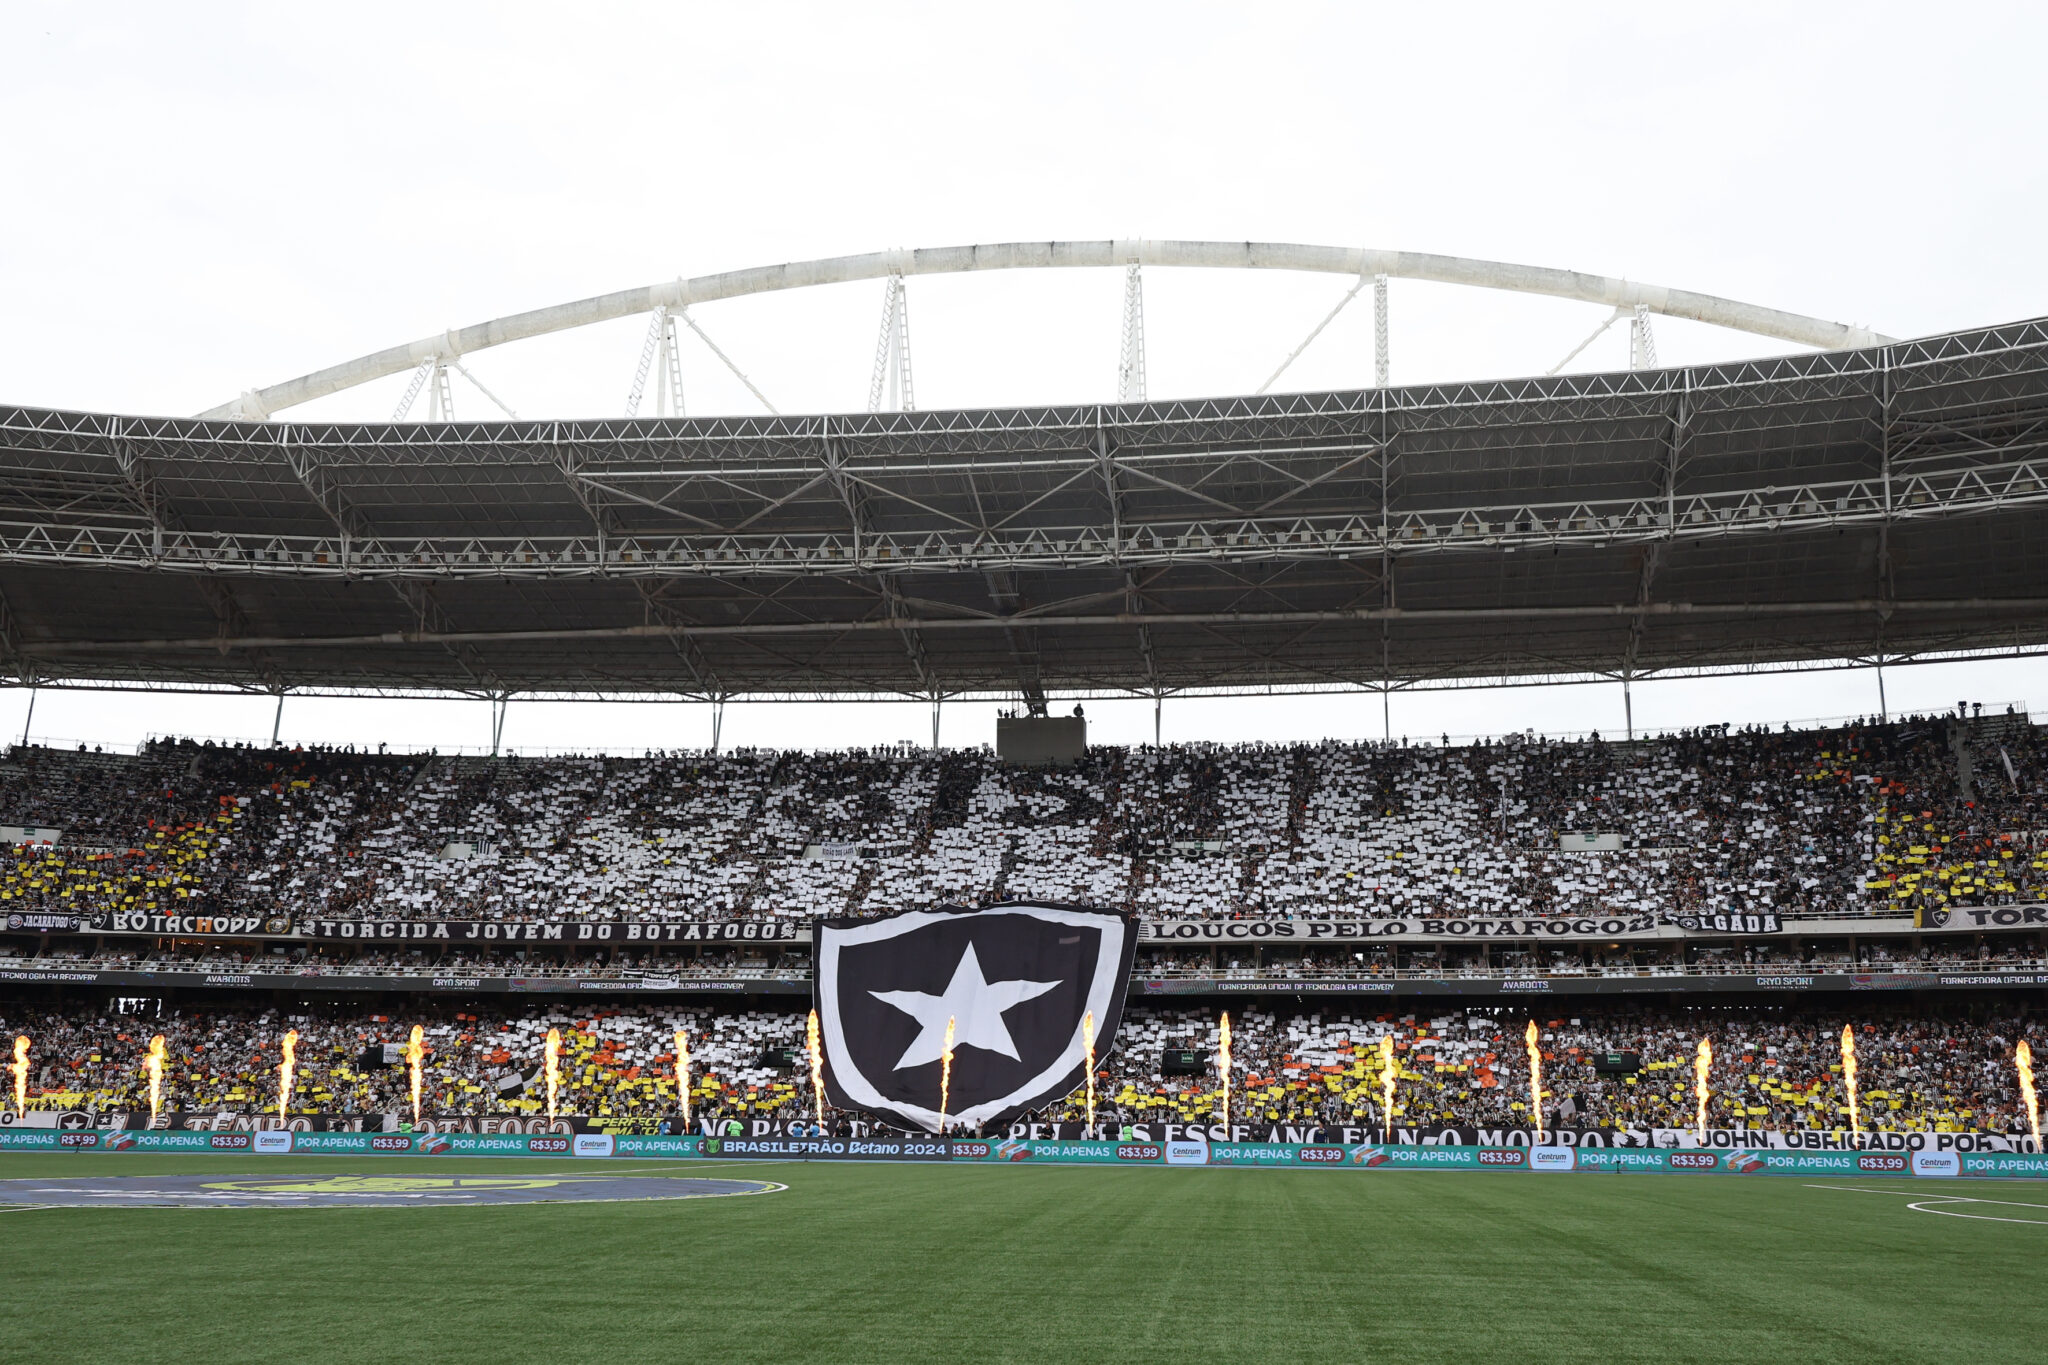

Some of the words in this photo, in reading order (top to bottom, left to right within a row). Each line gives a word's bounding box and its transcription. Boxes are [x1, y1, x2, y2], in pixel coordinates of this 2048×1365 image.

[324, 920, 450, 939] TORCIDA
[466, 922, 562, 941] JOVEM
[578, 923, 612, 941] DO
[627, 922, 776, 941] BOTAFOGO
[1152, 921, 1296, 939] LOUCOS
[1307, 921, 1408, 939] PELO
[1420, 918, 1626, 936] BOTAFOGO
[13, 1134, 54, 1146] APENAS
[137, 1136, 160, 1147] POR
[162, 1136, 205, 1148] APENAS
[212, 1136, 248, 1149] R$3,99
[260, 1136, 286, 1146] Centrum
[297, 1137, 320, 1148] POR
[322, 1137, 365, 1149] APENAS
[372, 1138, 409, 1151] R$3,99
[453, 1139, 476, 1150] POR
[478, 1139, 522, 1151] APENAS
[530, 1139, 567, 1153] R$3,99
[580, 1139, 607, 1149] Centrum
[1695, 1130, 1775, 1151] JOHN,
[1784, 1131, 1926, 1151] OBRIGADO
[619, 1141, 643, 1152] POR
[645, 1141, 690, 1153] APENAS
[724, 1138, 844, 1155] BRASILEIRÃO
[848, 1141, 900, 1156] Betano
[903, 1144, 947, 1157] 2024
[1034, 1146, 1057, 1157] POR
[1060, 1146, 1110, 1158] APENAS
[1118, 1146, 1158, 1159] R$3,99
[1172, 1147, 1202, 1157] Centrum
[1215, 1148, 1239, 1159] POR
[1242, 1148, 1292, 1160] APENAS
[1301, 1149, 1342, 1161] R$3,99
[1392, 1150, 1417, 1162] POR
[1419, 1151, 1471, 1163] APENAS
[1480, 1151, 1522, 1165] R$3,99
[1537, 1152, 1567, 1162] Centrum
[1581, 1153, 1607, 1165] POR
[1609, 1154, 1663, 1166] APENAS
[1672, 1154, 1714, 1168] R$3,99
[1767, 1156, 1793, 1168] POR
[1795, 1156, 1851, 1169] APENAS
[1860, 1156, 1904, 1170] R$3,99
[1920, 1157, 1951, 1168] Centrum
[1967, 1159, 1995, 1171] POR
